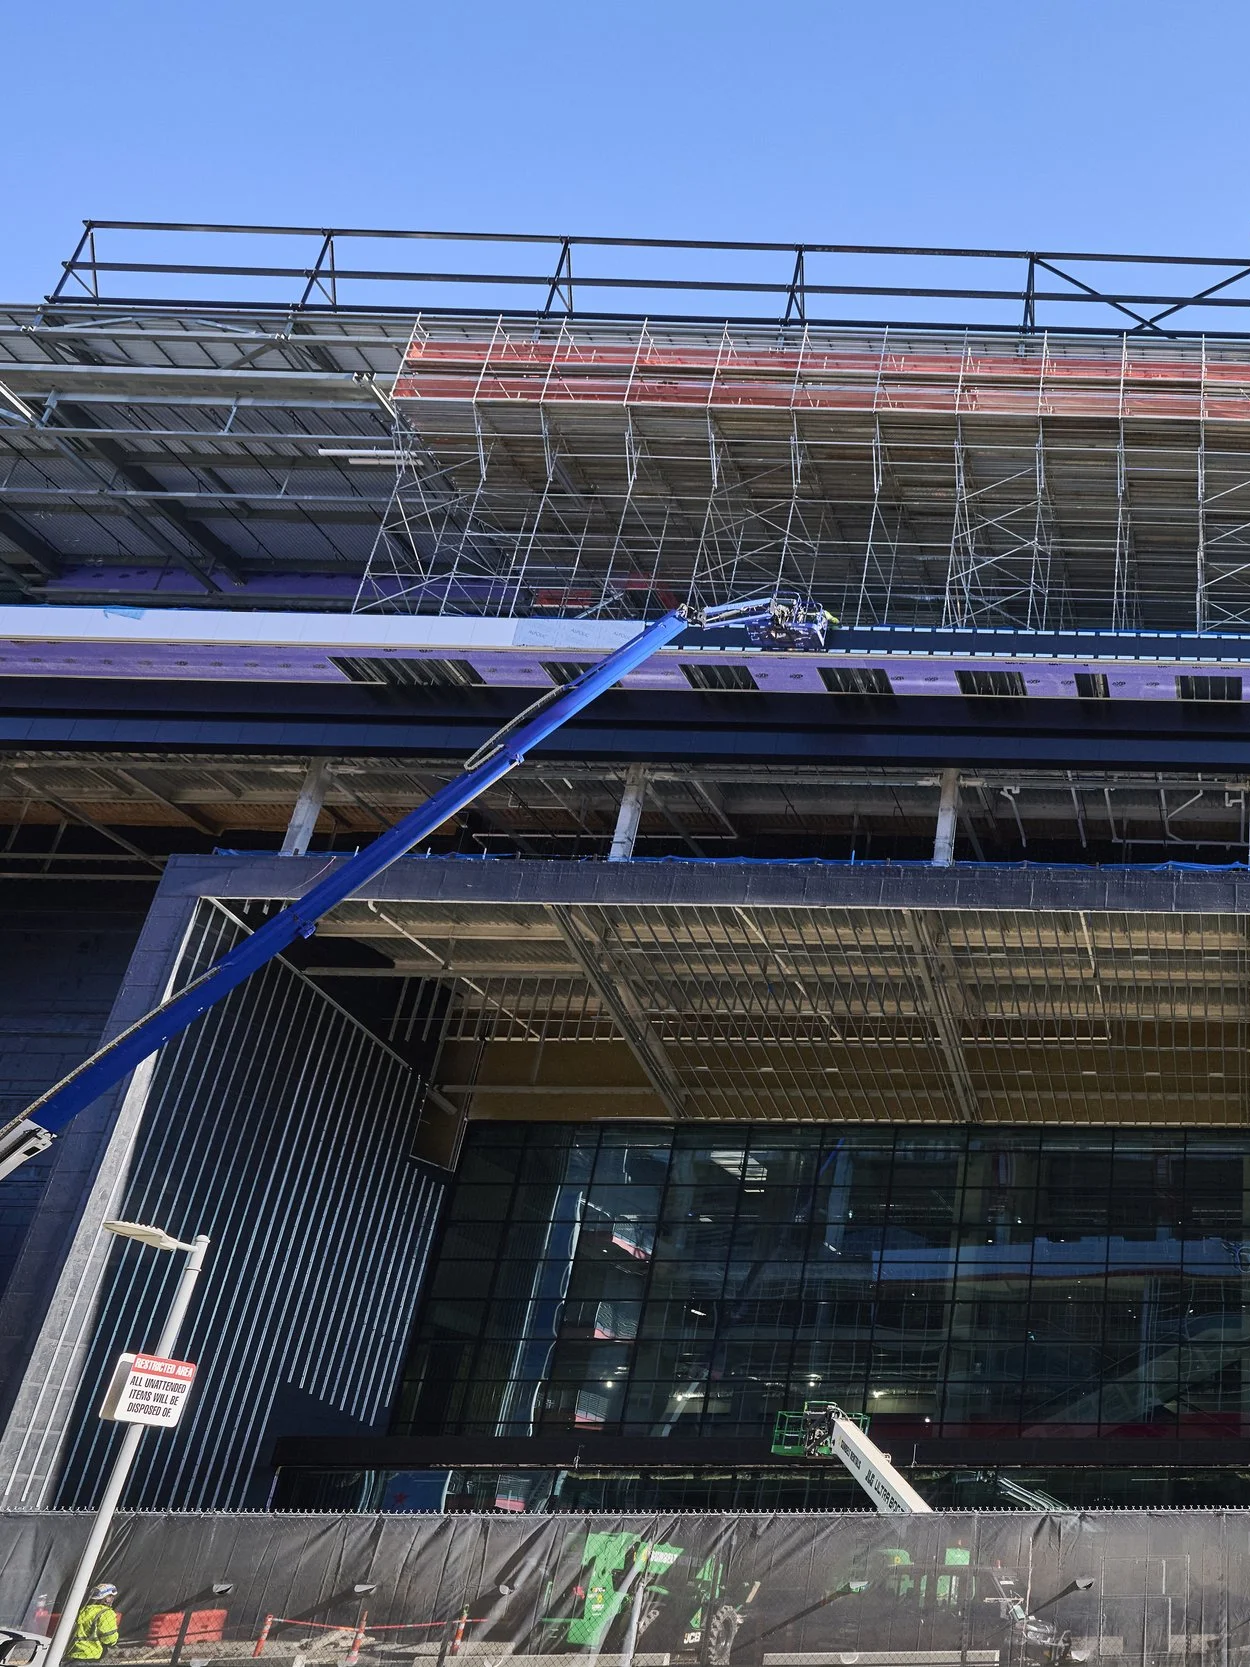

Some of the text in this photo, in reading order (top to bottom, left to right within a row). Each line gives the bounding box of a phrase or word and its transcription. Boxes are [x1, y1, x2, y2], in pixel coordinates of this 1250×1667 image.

[135, 1358, 193, 1377] RESTRICTED AREA
[130, 1376, 186, 1393] ALL UNATTENDED
[129, 1389, 179, 1405] ITEMS WILL BE
[127, 1403, 172, 1417] DISPOSED OF.
[683, 1631, 701, 1644] JCB
